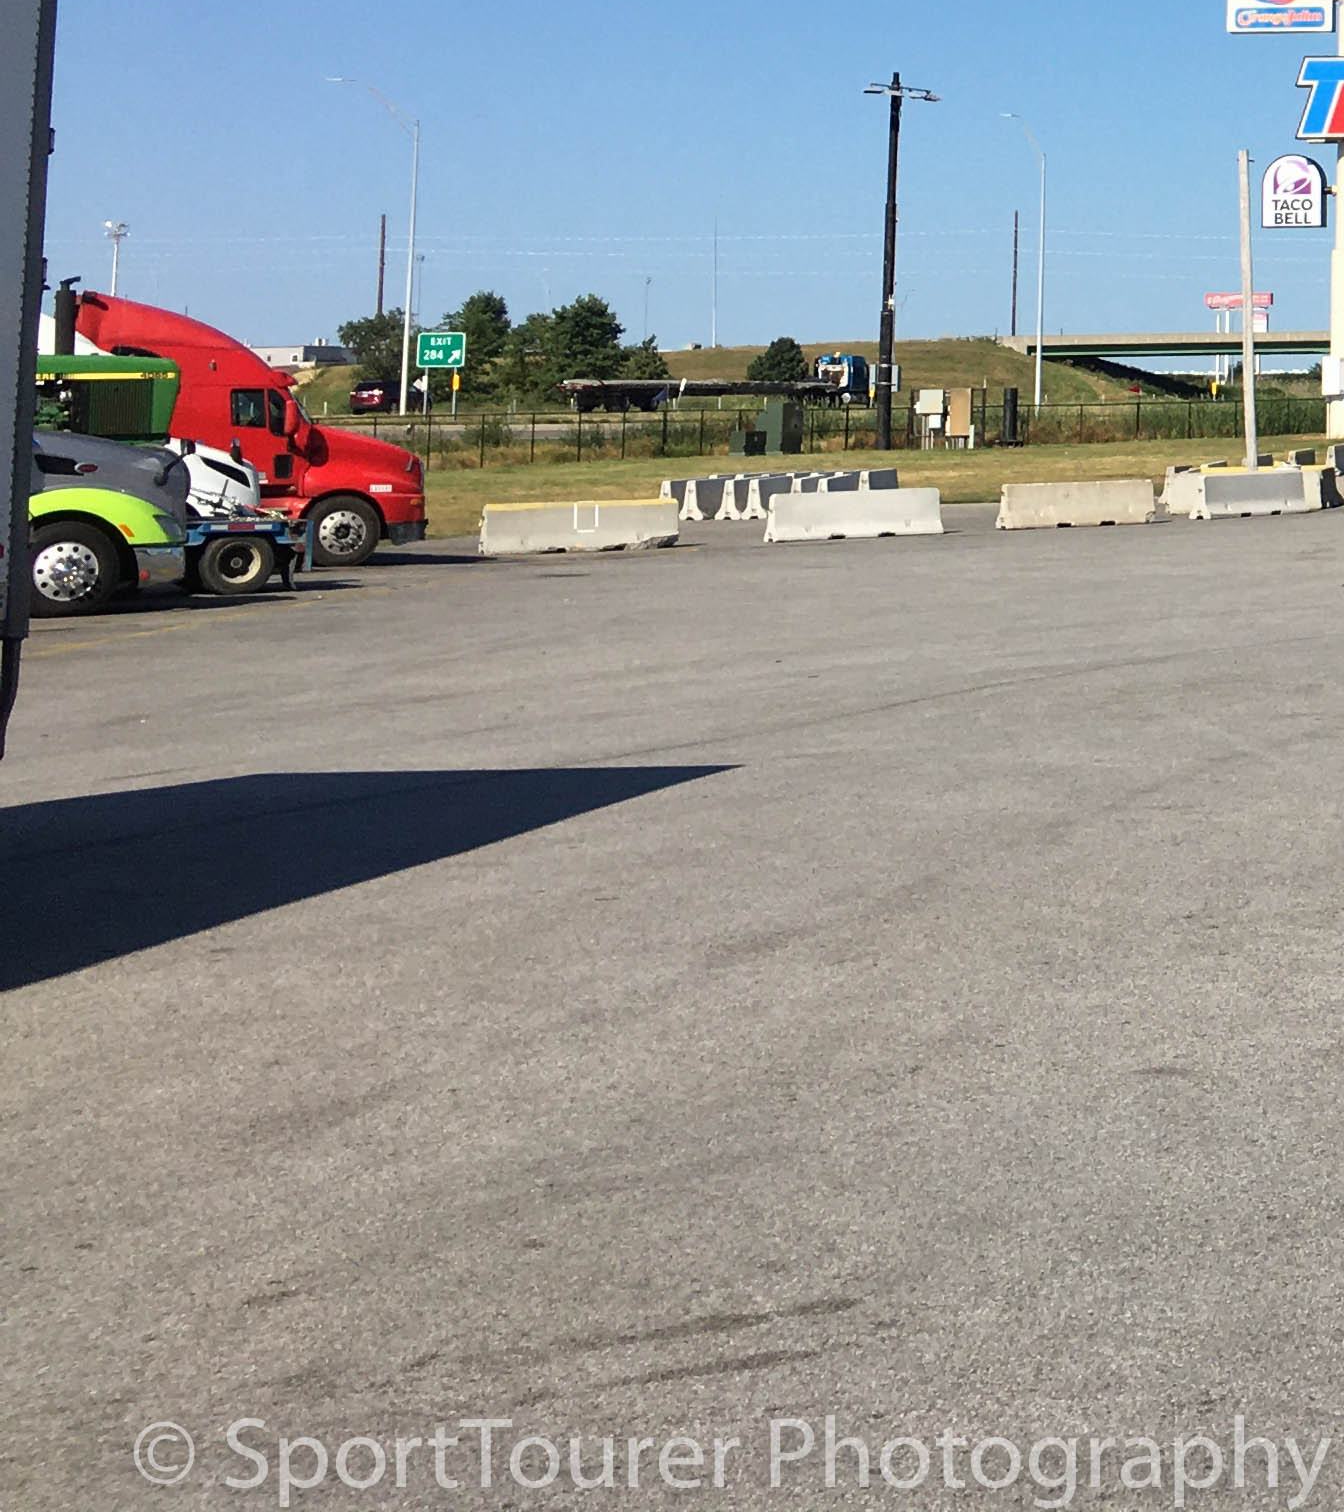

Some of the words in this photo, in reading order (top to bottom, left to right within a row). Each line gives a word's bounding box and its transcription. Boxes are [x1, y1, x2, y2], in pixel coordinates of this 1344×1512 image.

[1272, 199, 1313, 211] TACO
[1274, 212, 1312, 224] BELL
[430, 337, 452, 346] EXIT
[423, 349, 444, 361] 284
